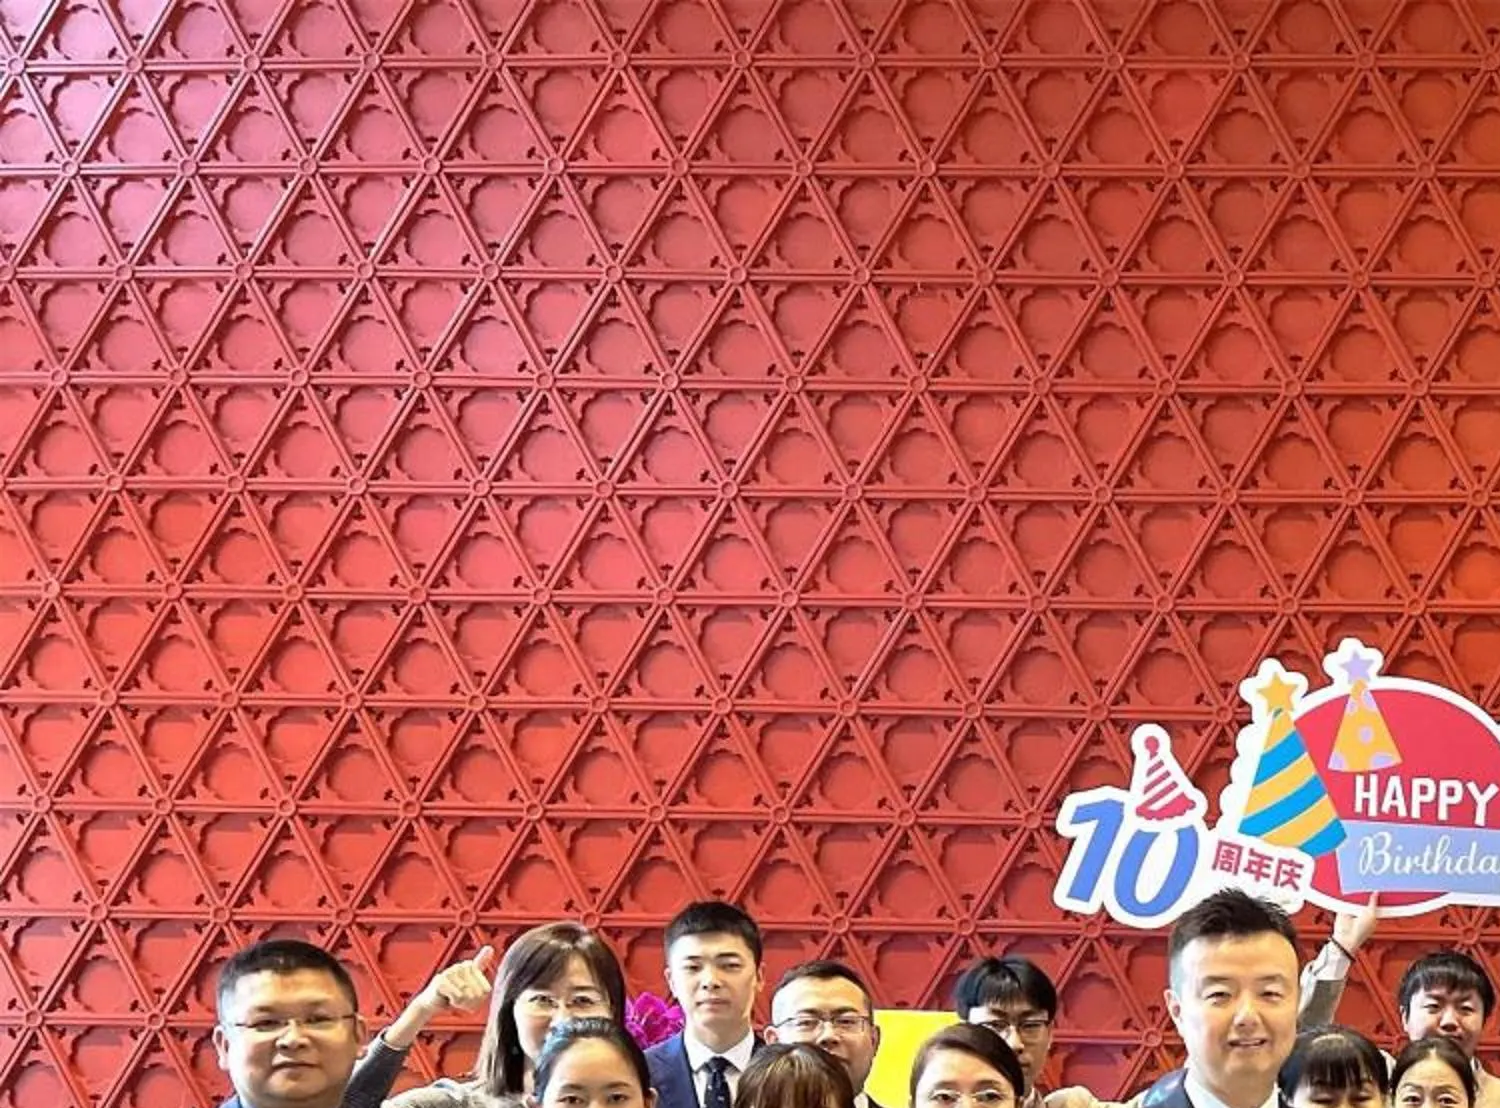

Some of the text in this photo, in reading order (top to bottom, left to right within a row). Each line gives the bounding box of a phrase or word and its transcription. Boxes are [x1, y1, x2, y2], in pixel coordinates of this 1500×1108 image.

[1354, 773, 1499, 828] HAPPY
[1211, 838, 1305, 892] 周年庆
